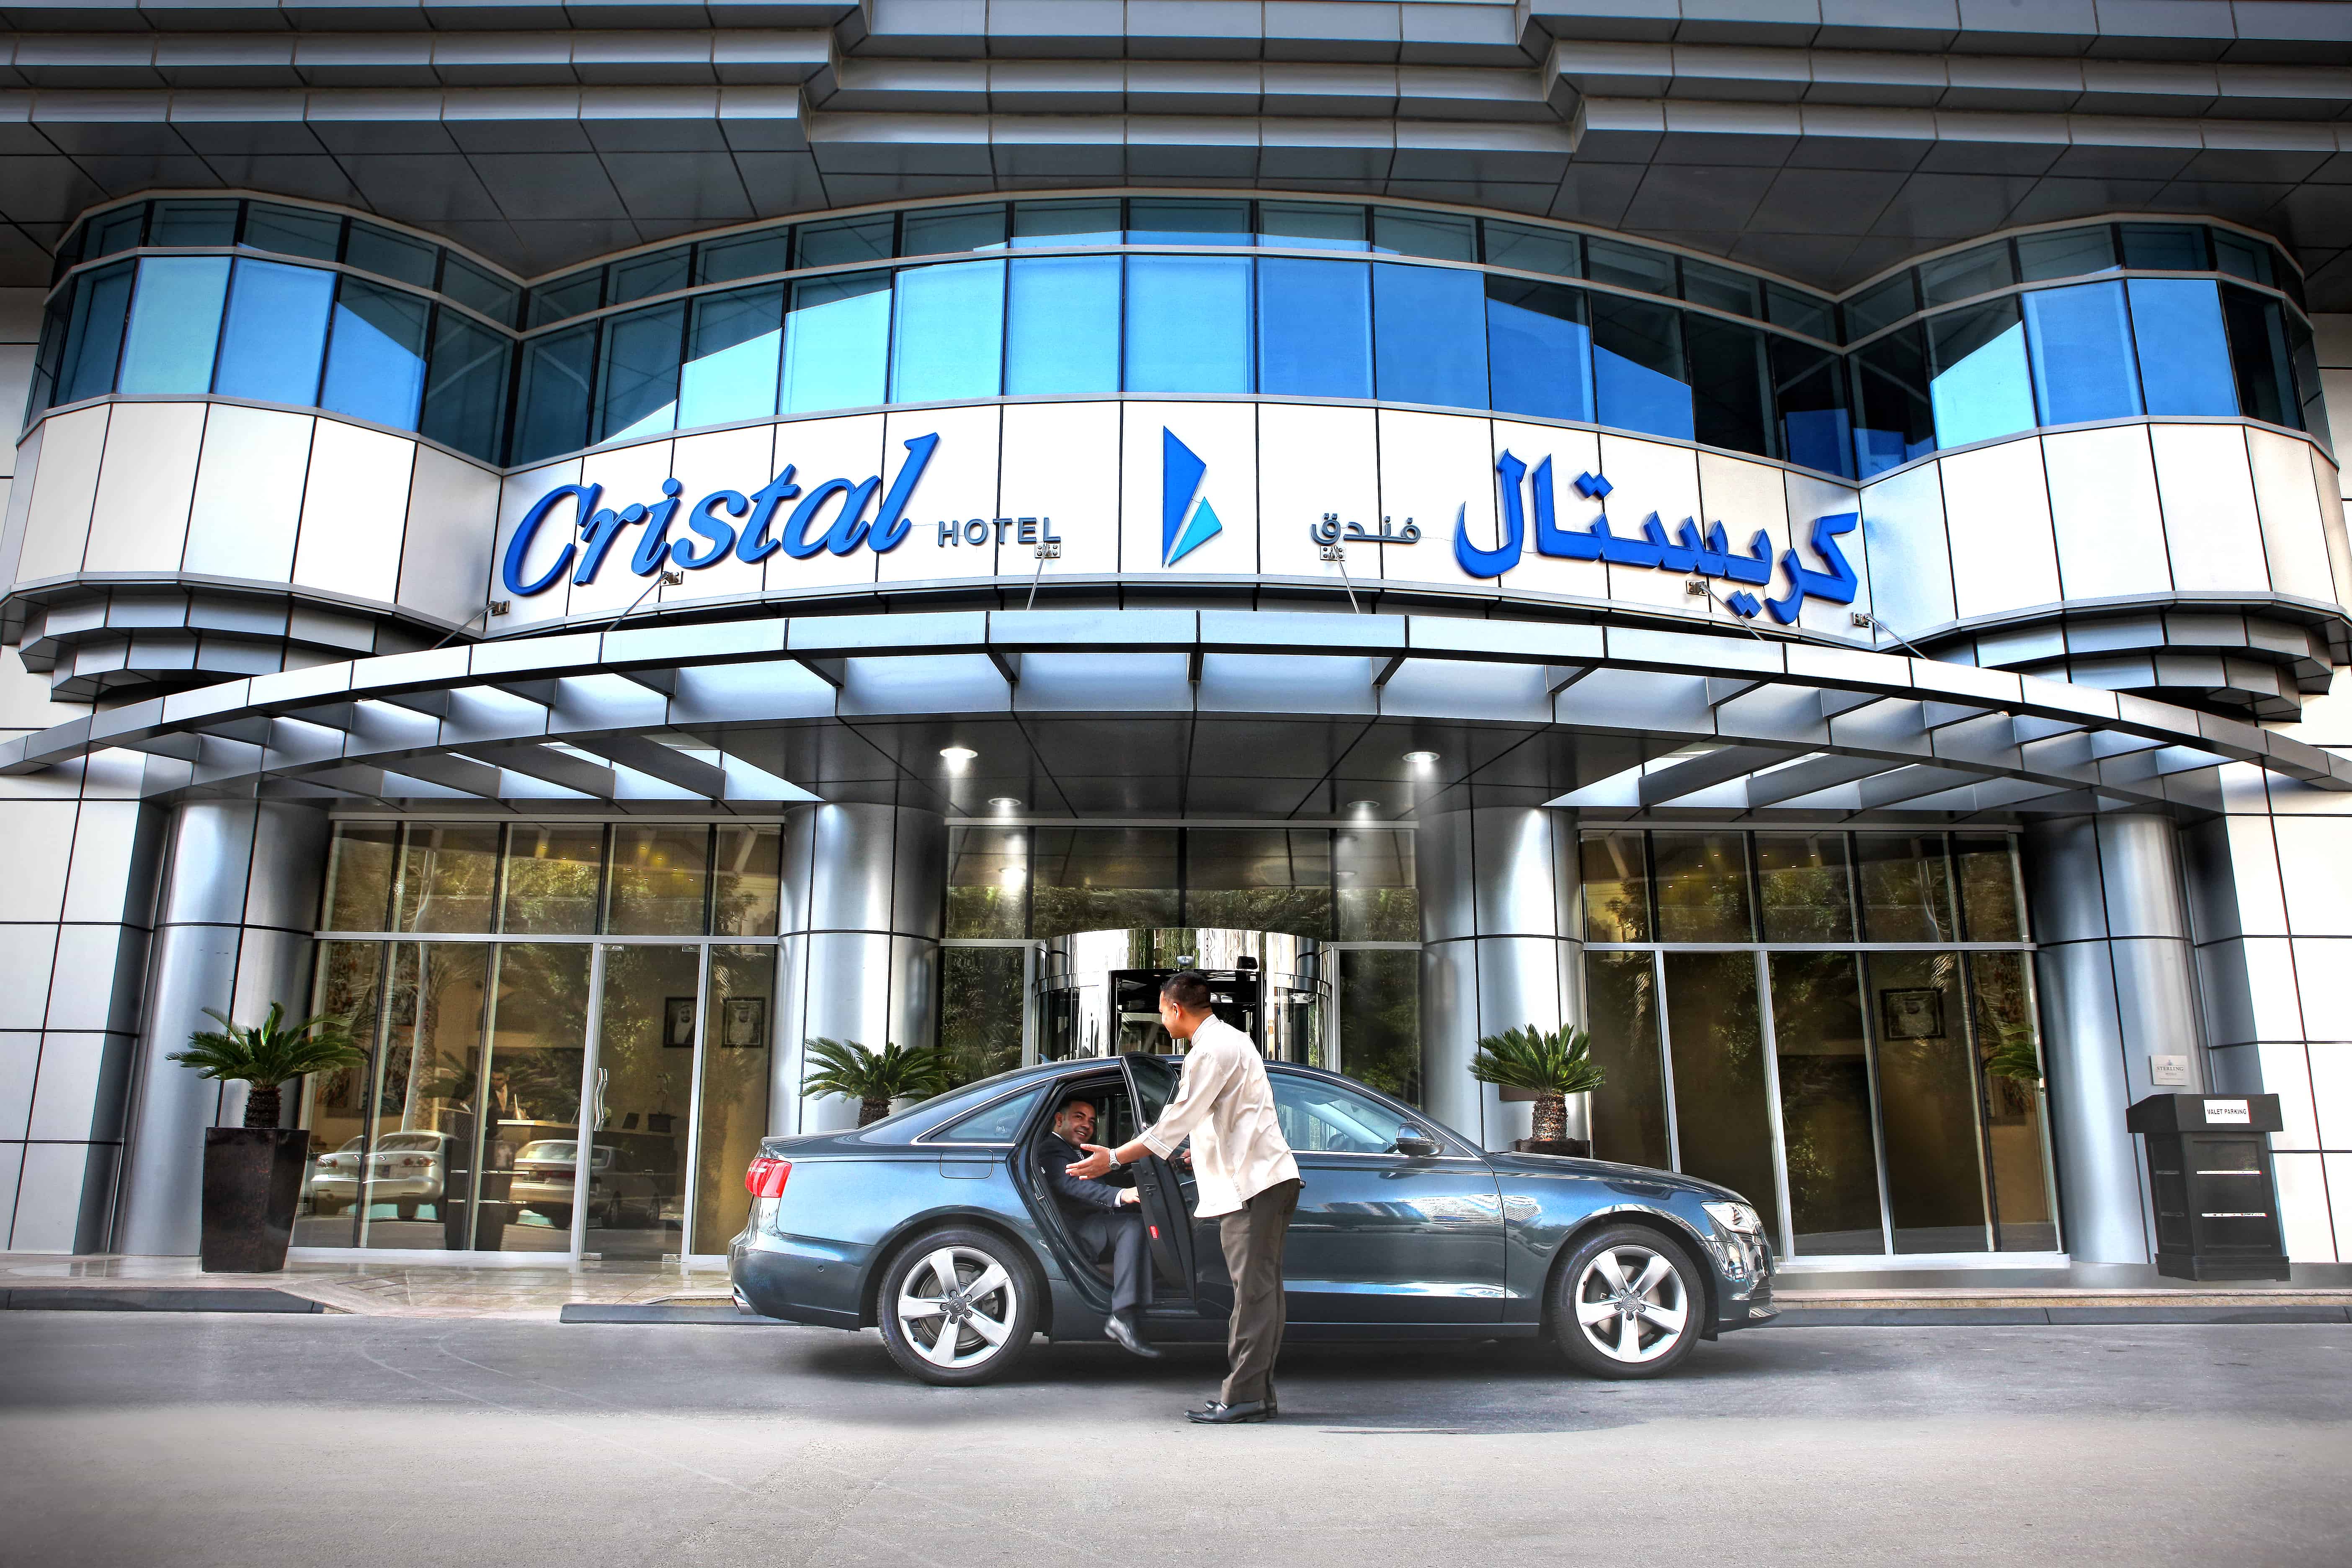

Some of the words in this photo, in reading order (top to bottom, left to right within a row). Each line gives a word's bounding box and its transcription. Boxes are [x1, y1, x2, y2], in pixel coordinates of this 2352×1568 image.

[503, 432, 939, 597] Cristal
[938, 516, 1062, 547] HOTEL
[1310, 512, 1421, 545] فندق
[1453, 448, 1859, 625] كريستال
